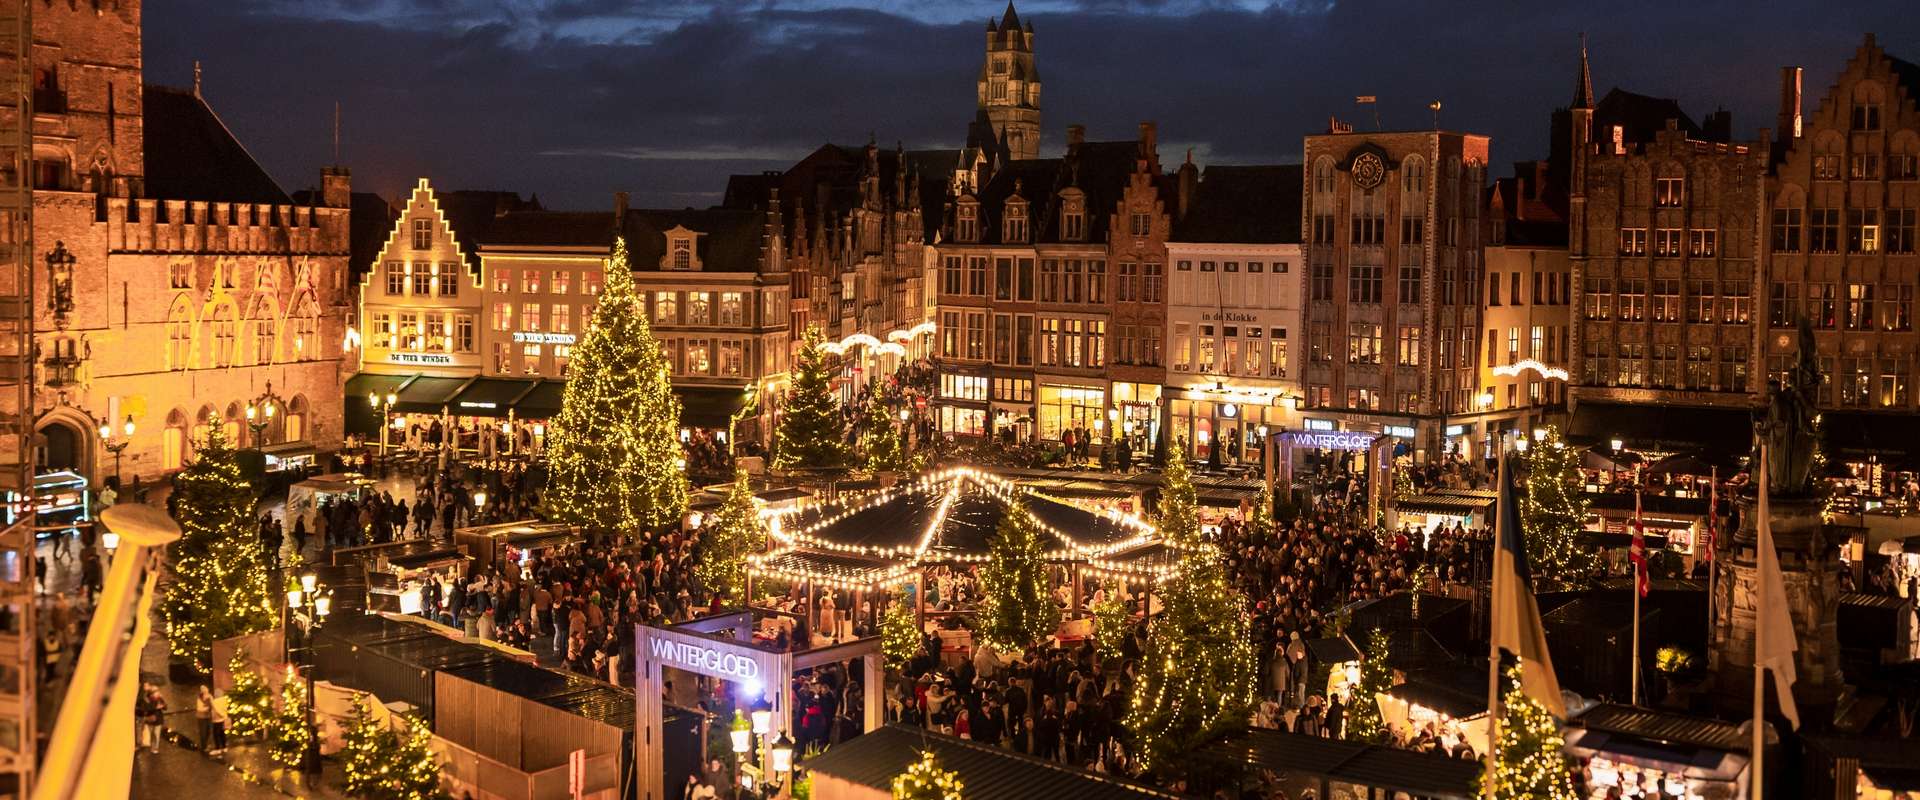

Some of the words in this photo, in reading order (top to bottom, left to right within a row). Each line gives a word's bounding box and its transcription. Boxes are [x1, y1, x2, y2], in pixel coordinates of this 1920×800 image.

[1225, 312, 1257, 322] Klokke
[402, 354, 418, 362] VIER
[421, 355, 450, 363] WINDEN
[1293, 433, 1376, 448] WINTERGLOED
[650, 636, 758, 679] WINTERGLOED
